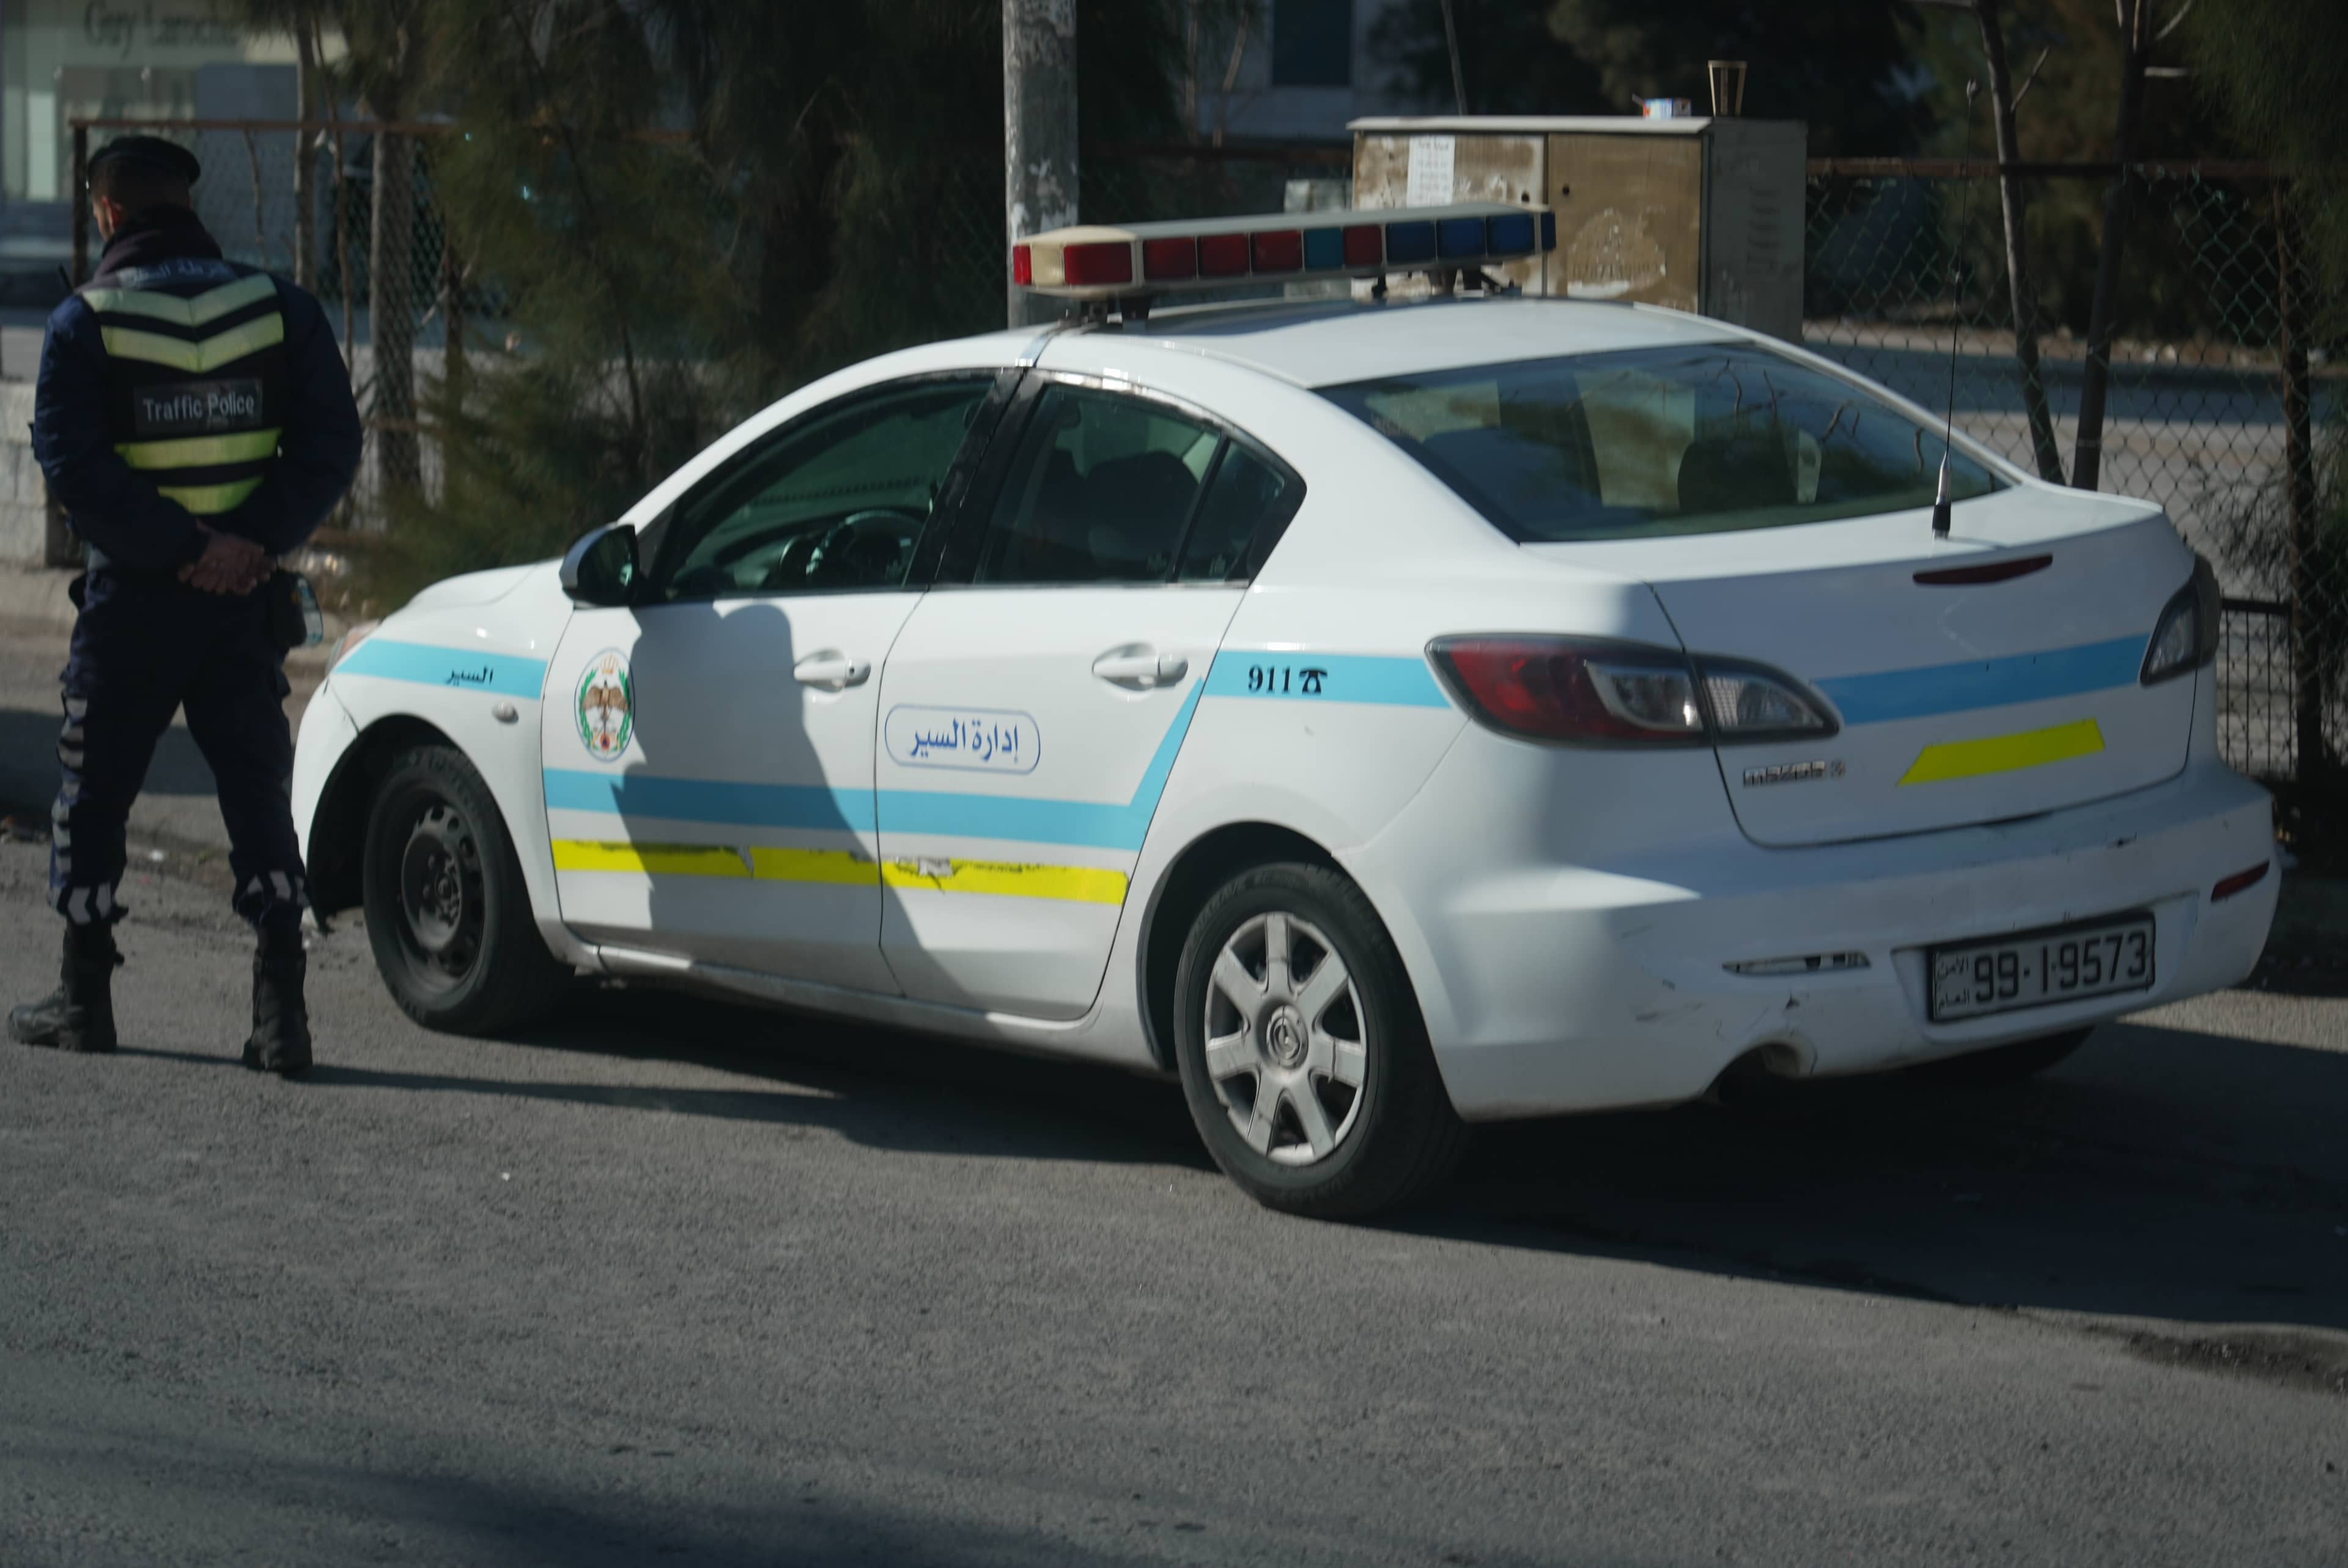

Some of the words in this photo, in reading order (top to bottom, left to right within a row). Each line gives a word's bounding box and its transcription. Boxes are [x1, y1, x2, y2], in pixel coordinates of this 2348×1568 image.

[143, 395, 203, 422] Traffic
[207, 390, 256, 417] Police
[445, 664, 493, 686] السير
[1248, 664, 1291, 693] 911
[910, 717, 966, 758] السير
[972, 718, 1019, 764] إدارة
